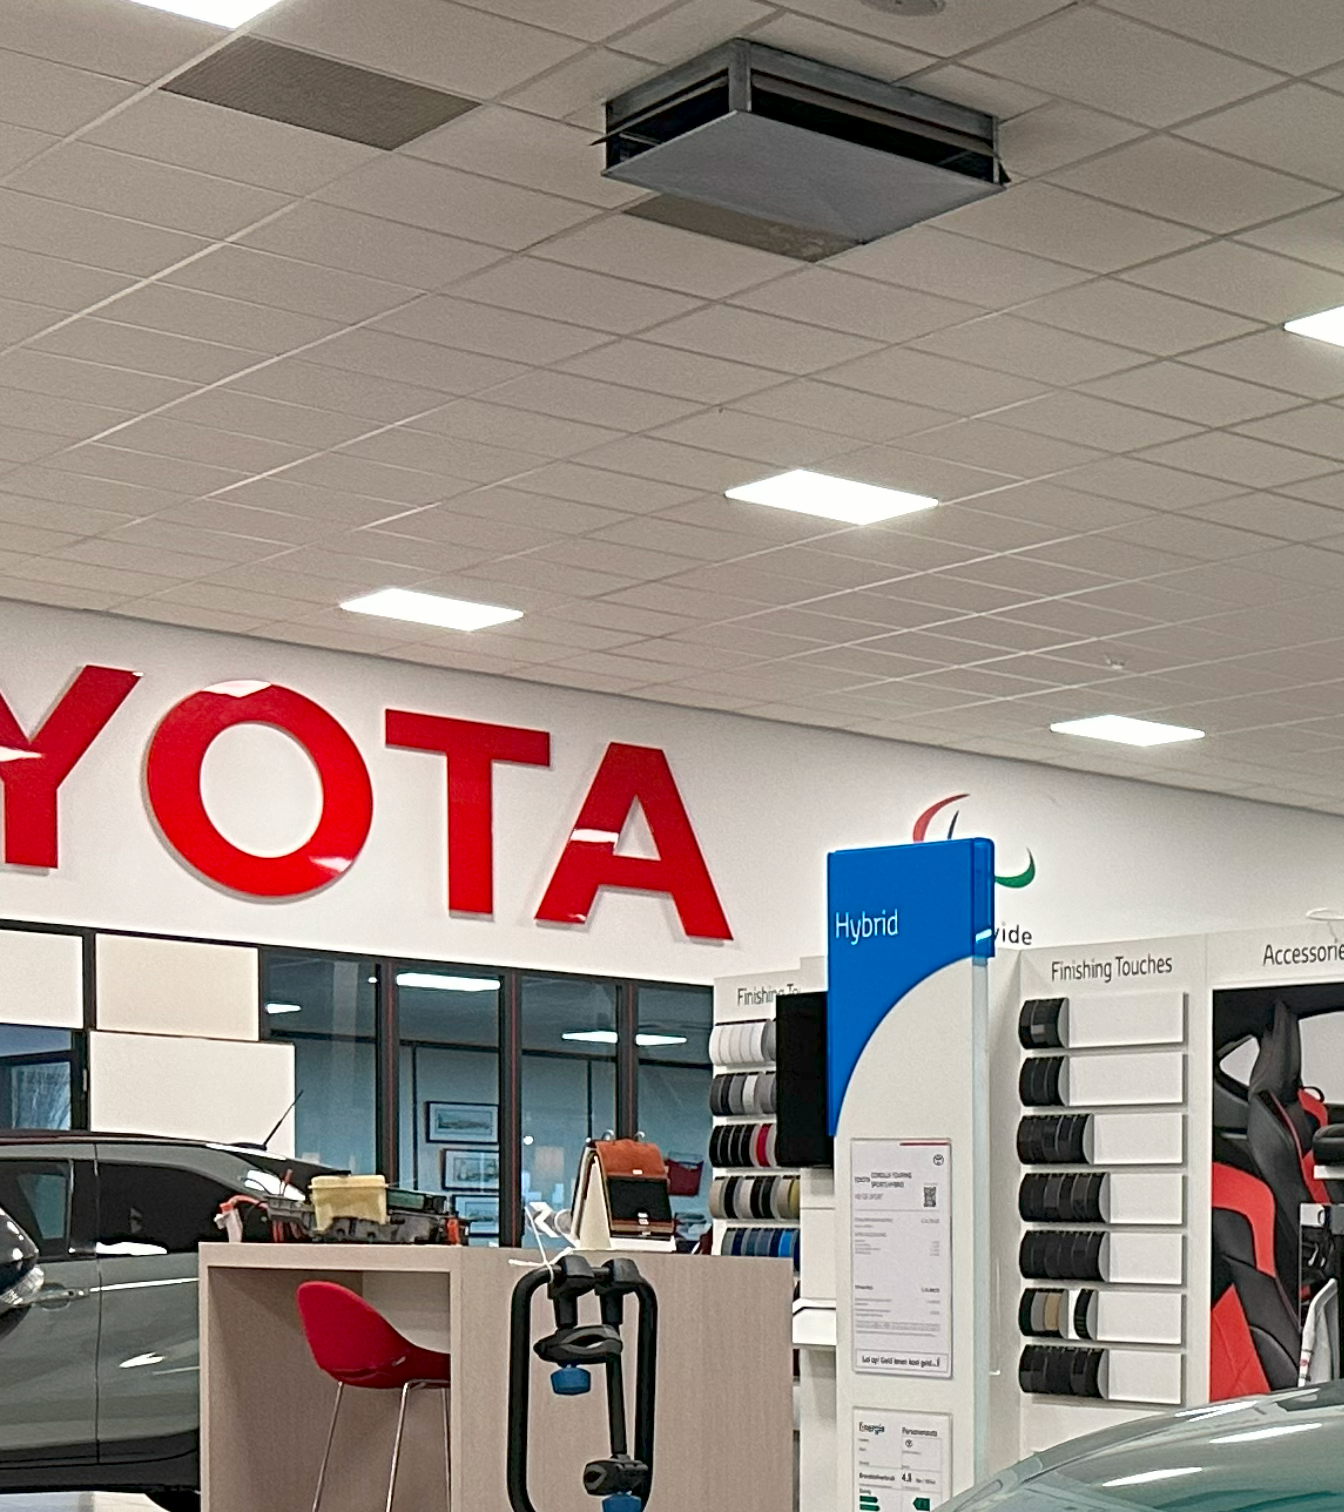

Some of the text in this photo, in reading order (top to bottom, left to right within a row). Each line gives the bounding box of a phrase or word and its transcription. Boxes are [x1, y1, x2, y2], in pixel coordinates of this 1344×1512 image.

[834, 908, 899, 946] Hybrid
[1050, 953, 1173, 983] Finishing Touches
